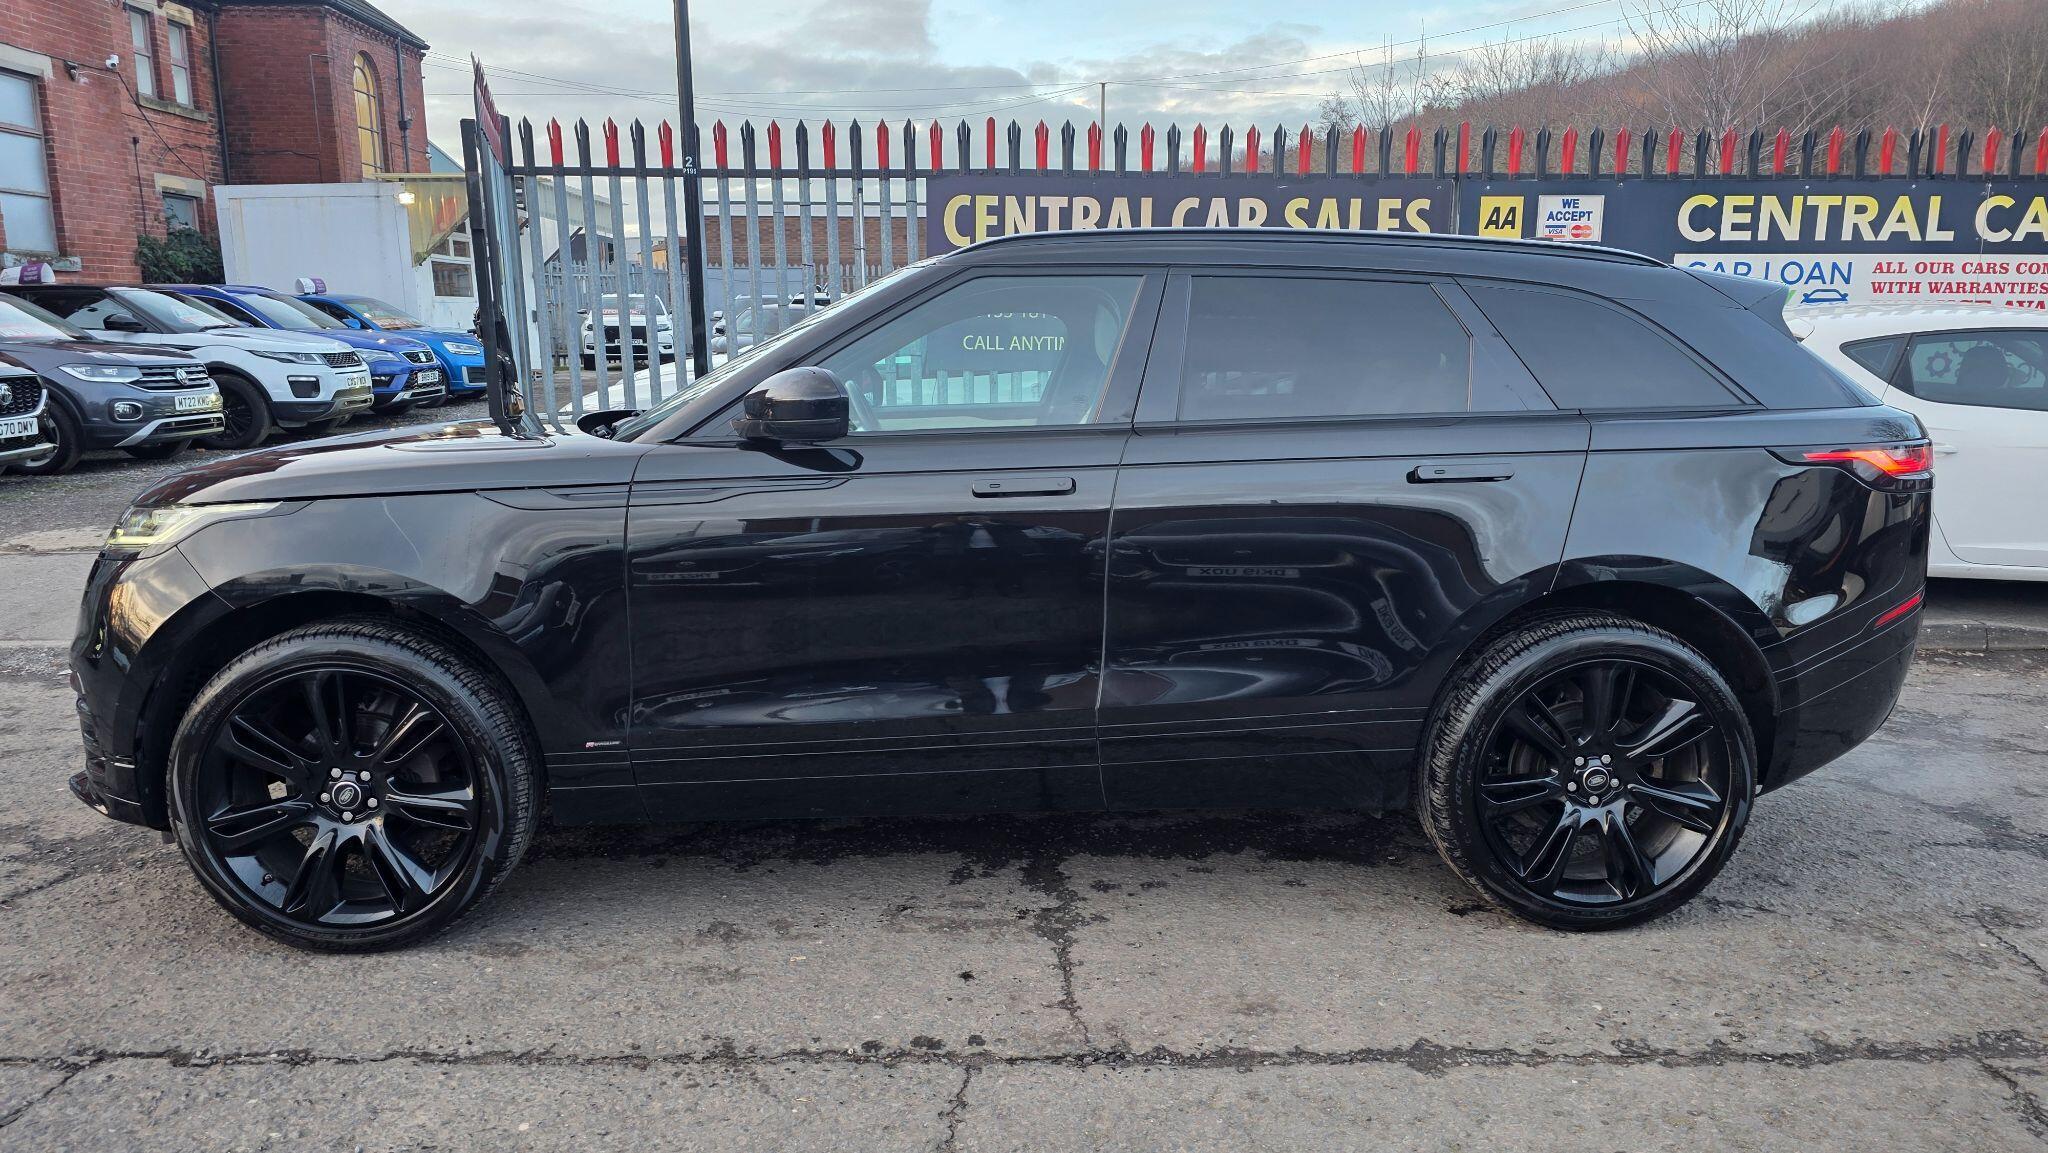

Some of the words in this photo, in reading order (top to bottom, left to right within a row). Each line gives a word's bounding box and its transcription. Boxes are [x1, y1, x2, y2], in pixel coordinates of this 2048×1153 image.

[685, 156, 693, 167] 2
[1561, 199, 1580, 209] WE
[943, 195, 1153, 248] CENTRAL
[1171, 197, 1268, 228] CAR
[1284, 197, 1432, 234] SALES
[1484, 206, 1517, 230] AA
[1546, 211, 1593, 222] ACCEPT
[1677, 194, 1955, 242] CENTRAL
[1764, 260, 1853, 285] LOAN
[1872, 262, 1908, 274] ALL
[1914, 262, 1955, 274] OUR
[1961, 262, 2010, 275] CARS
[1871, 281, 1922, 294] WITH
[1928, 281, 2048, 294] WARRANTIES
[962, 335, 1005, 351] CALL
[178, 396, 197, 409] MT22
[18, 420, 34, 433] DMY
